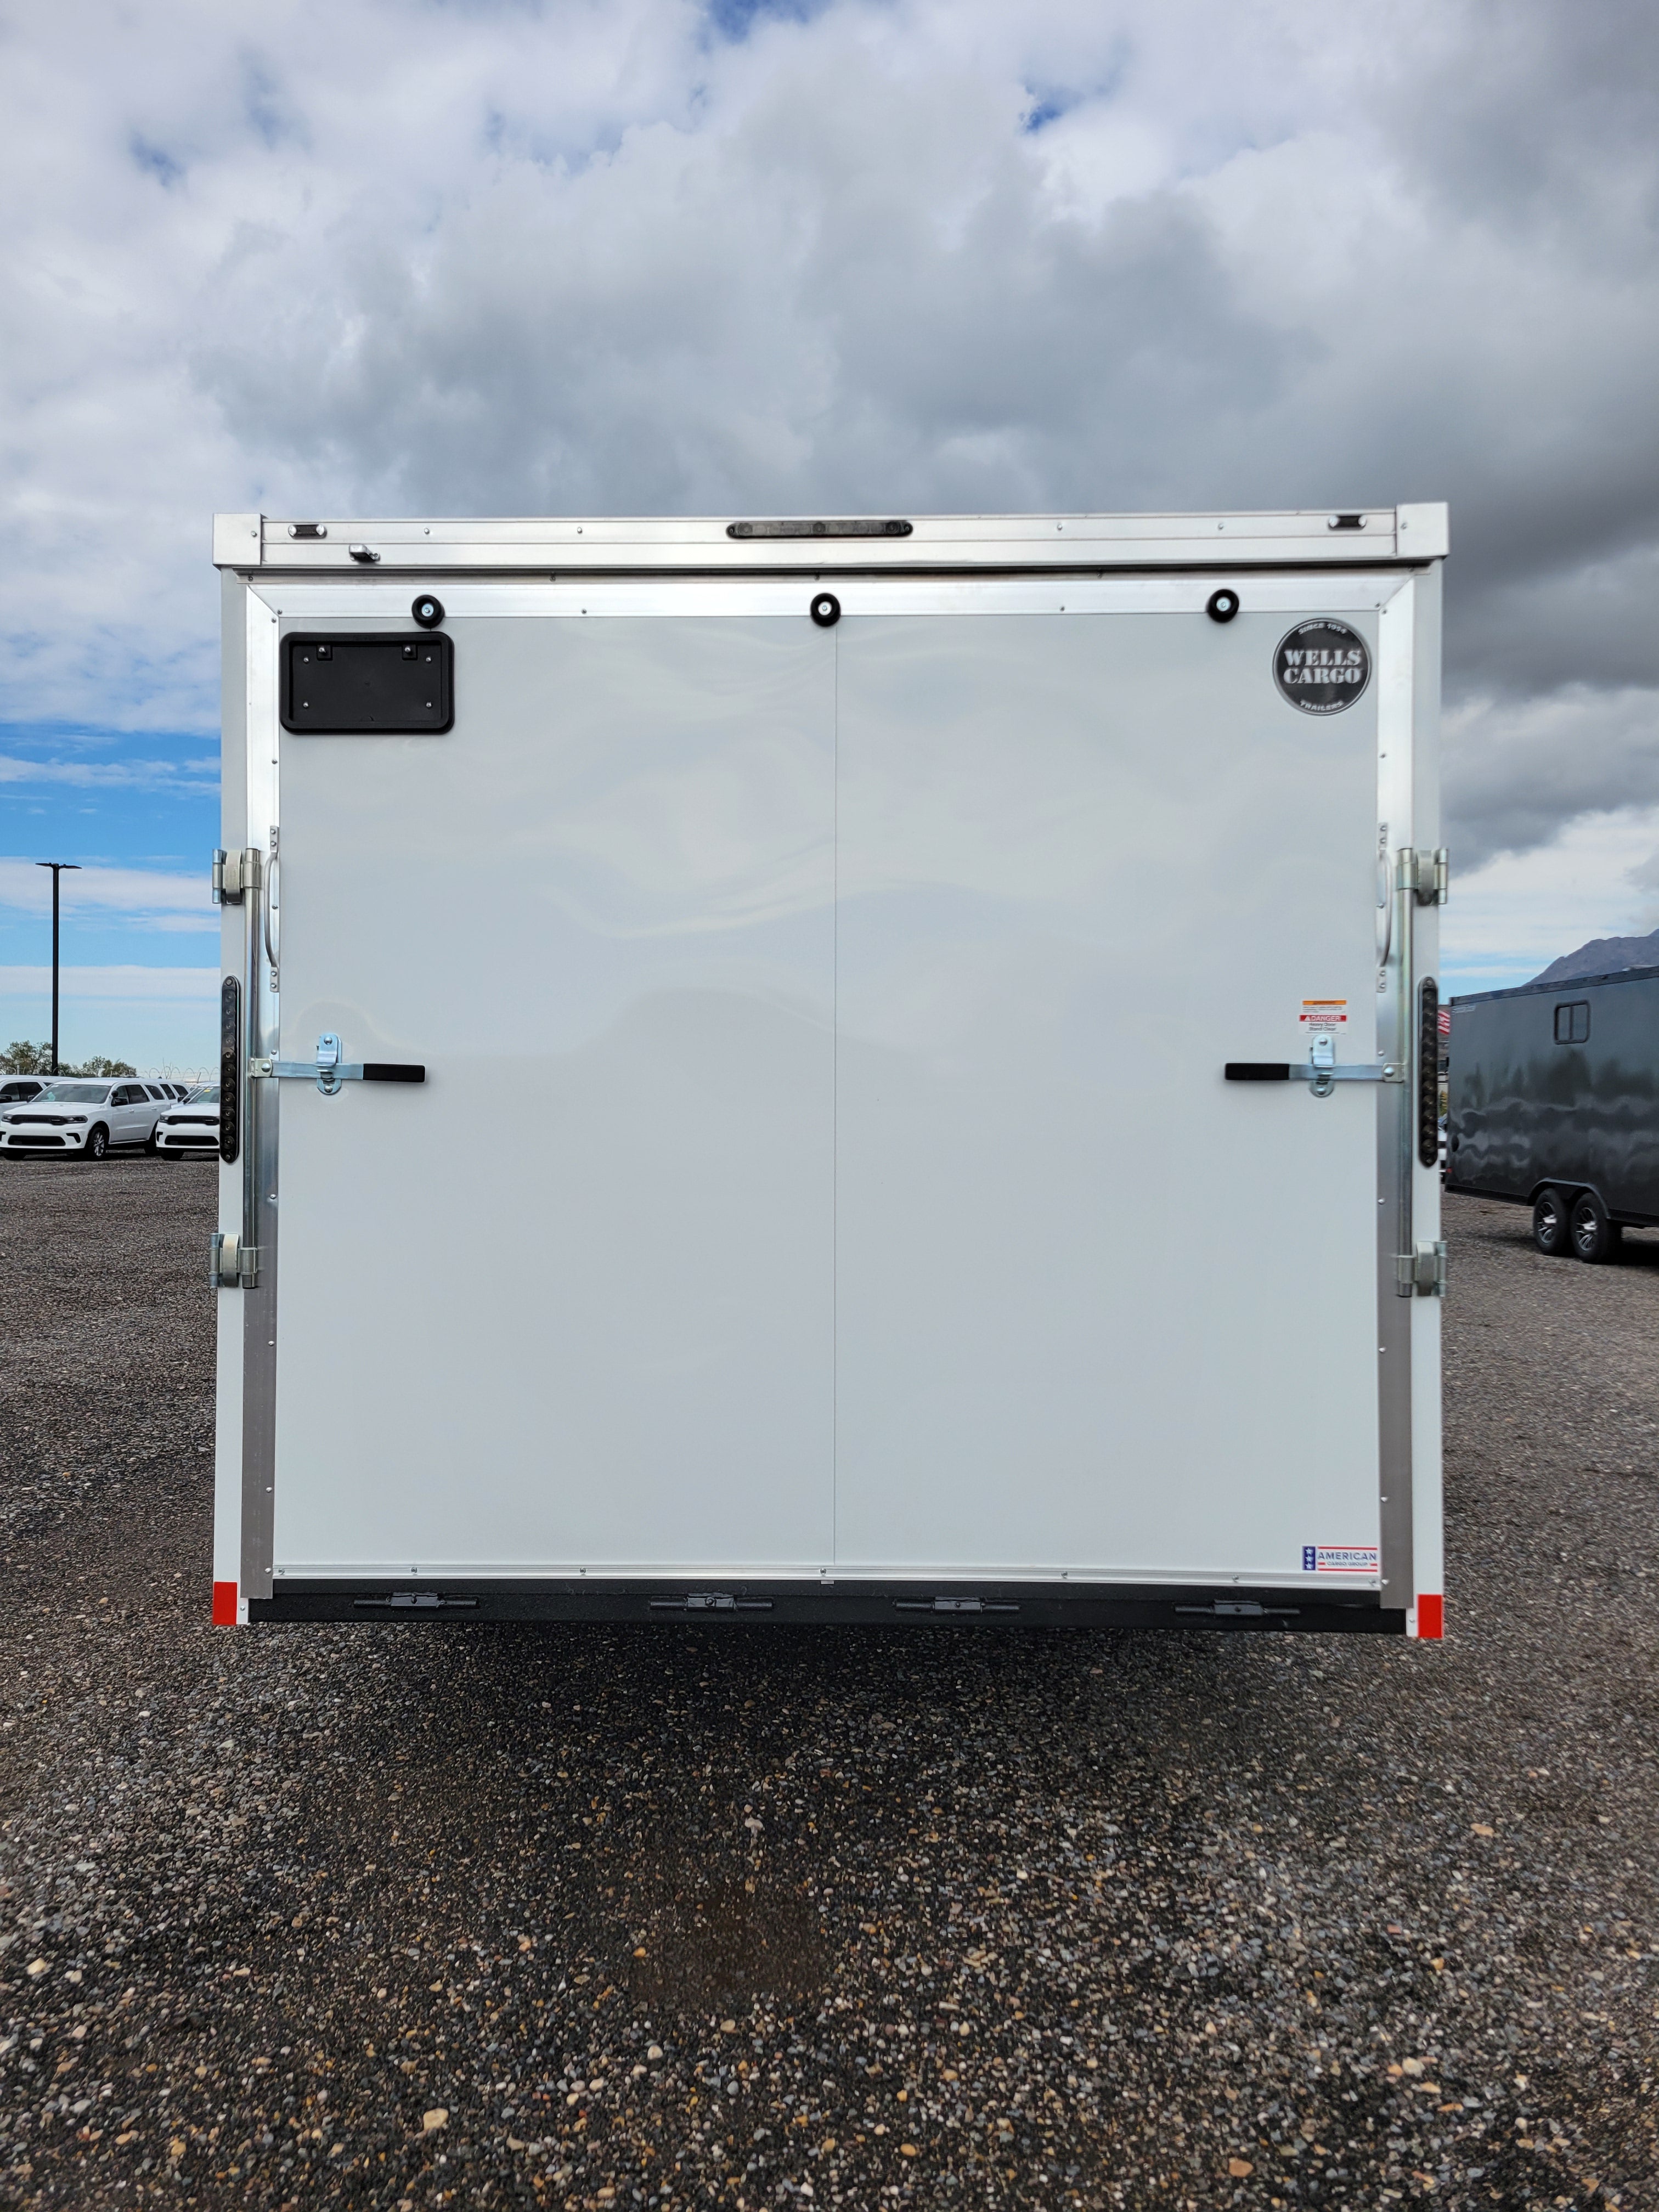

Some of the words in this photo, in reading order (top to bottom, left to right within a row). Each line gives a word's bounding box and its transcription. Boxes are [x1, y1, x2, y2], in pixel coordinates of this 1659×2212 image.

[1298, 622, 1325, 635] SINCE
[1284, 650, 1362, 666] WELLS
[1283, 668, 1363, 684] CARGO
[1299, 699, 1344, 711] TRAILERS
[1318, 1551, 1377, 1560] AMERICAN
